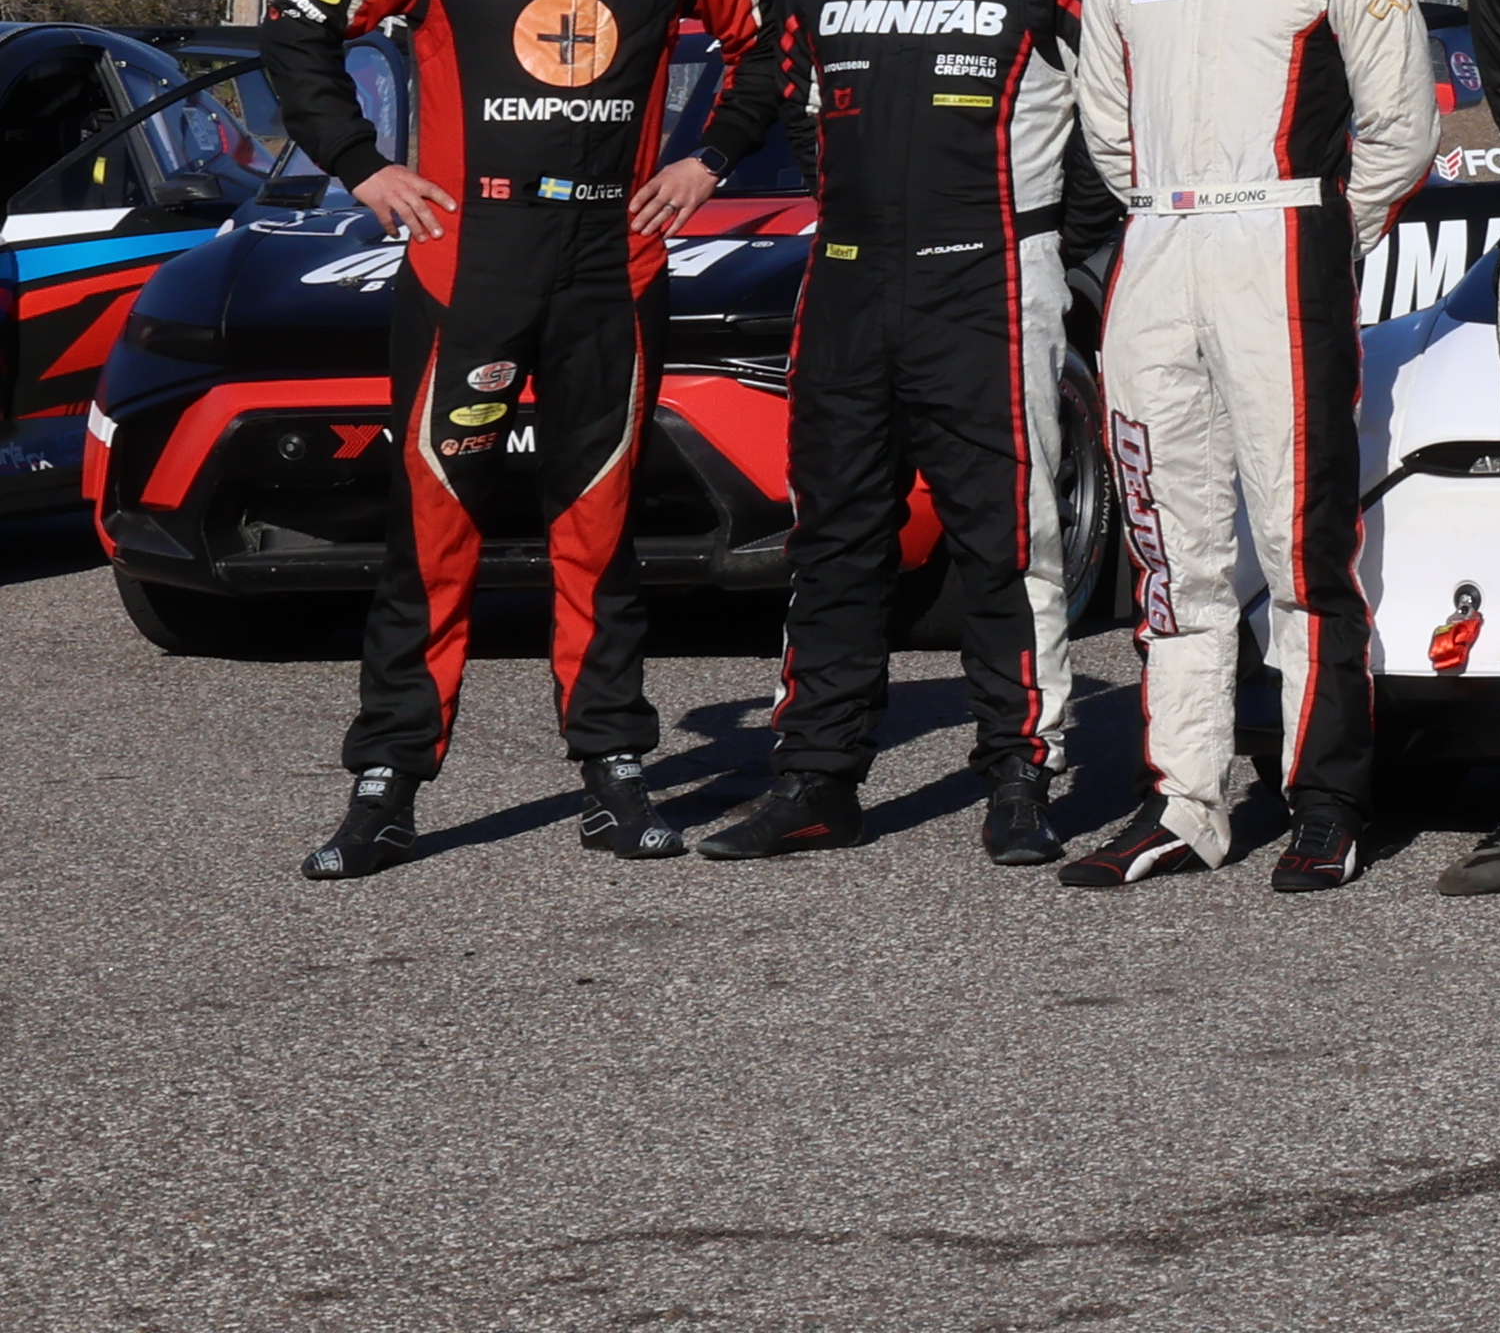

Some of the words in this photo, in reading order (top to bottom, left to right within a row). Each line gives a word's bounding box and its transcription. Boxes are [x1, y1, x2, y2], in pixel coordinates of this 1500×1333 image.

[819, 0, 1007, 37] OMNIFAB
[484, 97, 635, 122] KEMPOWER
[480, 176, 511, 199] 16
[1198, 195, 1211, 206] M.
[1215, 190, 1267, 204] DEJONG
[358, 782, 386, 795] OMP
